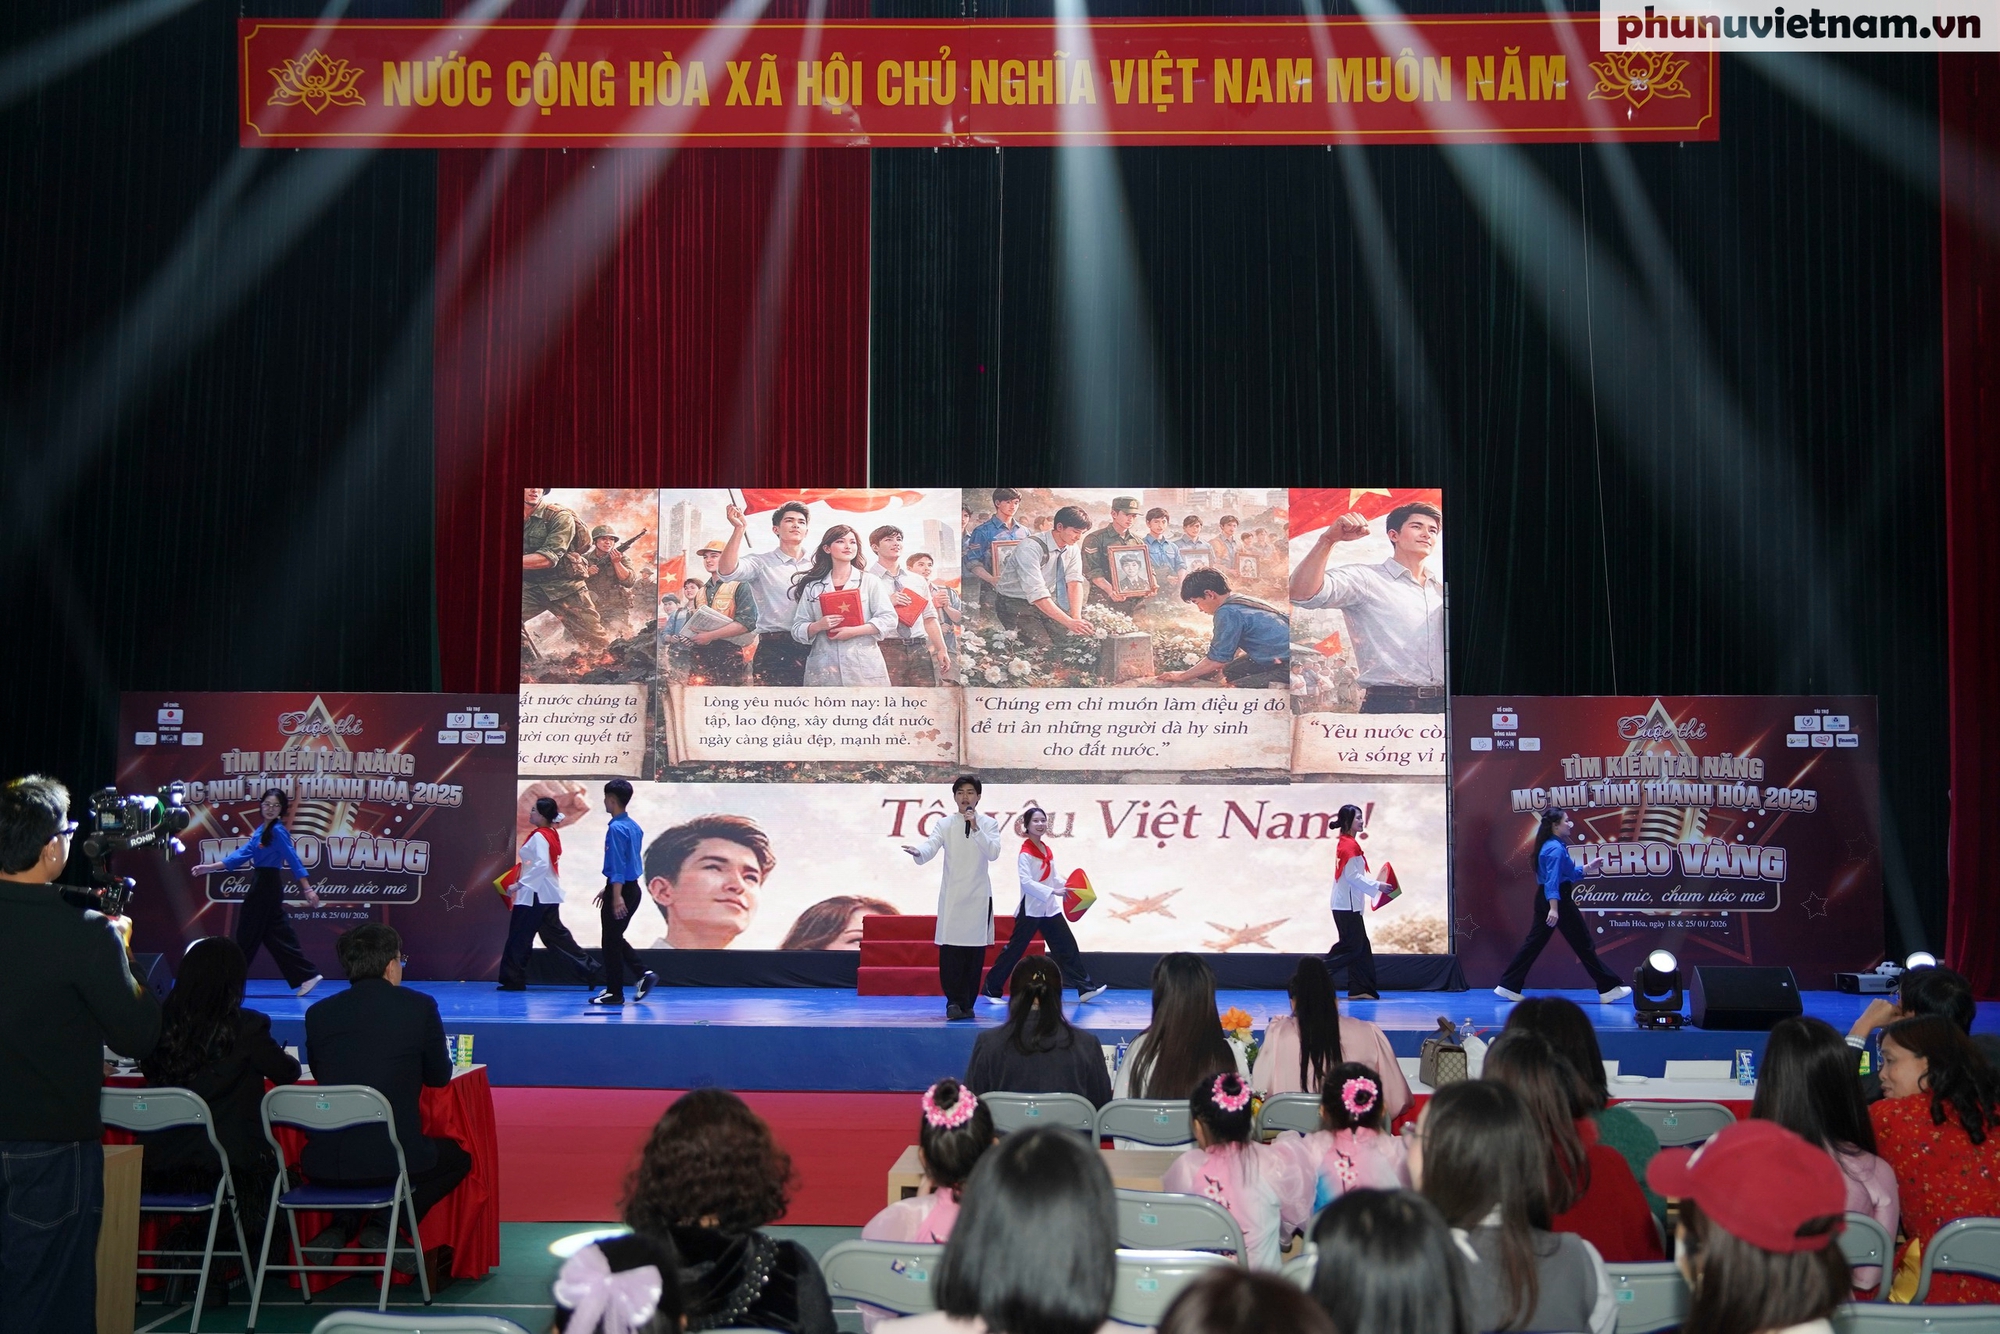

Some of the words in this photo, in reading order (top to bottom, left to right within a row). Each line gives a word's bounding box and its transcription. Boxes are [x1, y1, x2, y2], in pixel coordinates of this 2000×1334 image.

[383, 51, 492, 107] NƯỚC
[506, 52, 615, 115] CỘNG
[629, 51, 710, 107] HÒA
[725, 53, 782, 106] XÃ
[798, 52, 862, 115] HỘI
[877, 45, 957, 106] CHỦ
[970, 50, 1097, 106] NGHĨA
[1109, 50, 1199, 112] VIỆT
[1214, 58, 1313, 104] NAM
[1327, 47, 1452, 103] MUÔN
[1466, 46, 1567, 102] NĂM
[537, 694, 574, 706] nước
[577, 694, 621, 708] chúng
[624, 696, 637, 706] ta
[703, 696, 739, 711] Lòng
[743, 696, 769, 711] yêu
[814, 696, 846, 708] hôm
[851, 699, 880, 711] nay:
[884, 696, 896, 708] là
[901, 696, 928, 709] học
[975, 696, 1041, 714] “Chúng
[1045, 700, 1072, 711] em
[1077, 696, 1103, 711] chỉ
[1163, 697, 1196, 711] làm
[1242, 698, 1259, 715] gi
[1263, 698, 1286, 711] đó
[278, 711, 333, 738] Cuộc
[331, 714, 363, 736] thi
[619, 712, 637, 724] đó
[705, 714, 730, 729] tập,
[735, 715, 757, 726] lao
[804, 715, 828, 729] xây
[899, 715, 935, 726] nước
[545, 733, 570, 742] con
[574, 729, 612, 745] quyết
[997, 720, 1016, 734] tri
[1020, 720, 1042, 734] ân
[1046, 720, 1102, 738] những
[1106, 721, 1157, 738] người
[1187, 721, 1209, 738] hy
[1213, 721, 1248, 735] sinh
[1363, 724, 1414, 739] nước
[1617, 715, 1675, 742] Cuộc
[1675, 717, 1708, 740] thi
[699, 734, 732, 748] ngày
[735, 733, 768, 748] càng
[841, 734, 880, 746] mạnh
[1043, 742, 1074, 756] cho
[1079, 740, 1107, 756] đất
[1111, 741, 1170, 756] nước.”
[221, 749, 260, 776] TÌM
[264, 745, 316, 775] KIẾM
[319, 746, 354, 775] TÀI
[357, 749, 415, 777] NĂNG
[572, 753, 600, 764] sinh
[1338, 748, 1359, 762] và
[1561, 754, 1602, 781] TÌM
[1605, 750, 1662, 779] KIẾM
[1664, 751, 1700, 780] TÀI
[1702, 753, 1764, 781] NĂNG
[208, 775, 246, 803] NHÍ
[299, 777, 366, 802] THANH
[368, 776, 411, 803] HÓA
[413, 782, 464, 808] 2025
[1511, 788, 1549, 812] MC
[1550, 781, 1590, 810] NHÍ
[1590, 777, 1642, 806] TỈNH
[1643, 783, 1715, 806] THANH
[1716, 780, 1764, 808] HÓA
[1764, 787, 1818, 813] 2025
[882, 799, 947, 838] Tô
[1096, 800, 1202, 848] Việt
[1218, 800, 1375, 840] Nam!
[130, 832, 156, 847] RONIN
[326, 832, 430, 876] VÀNG
[1678, 837, 1787, 882] VÀNG
[1571, 884, 1619, 905] Chạm
[1621, 888, 1654, 904] mic,
[1661, 884, 1704, 905] chạm
[1708, 886, 1736, 903] ước
[1740, 890, 1766, 902] mơ
[1632, 920, 1648, 928] Hóa,
[1649, 920, 1665, 929] ngày
